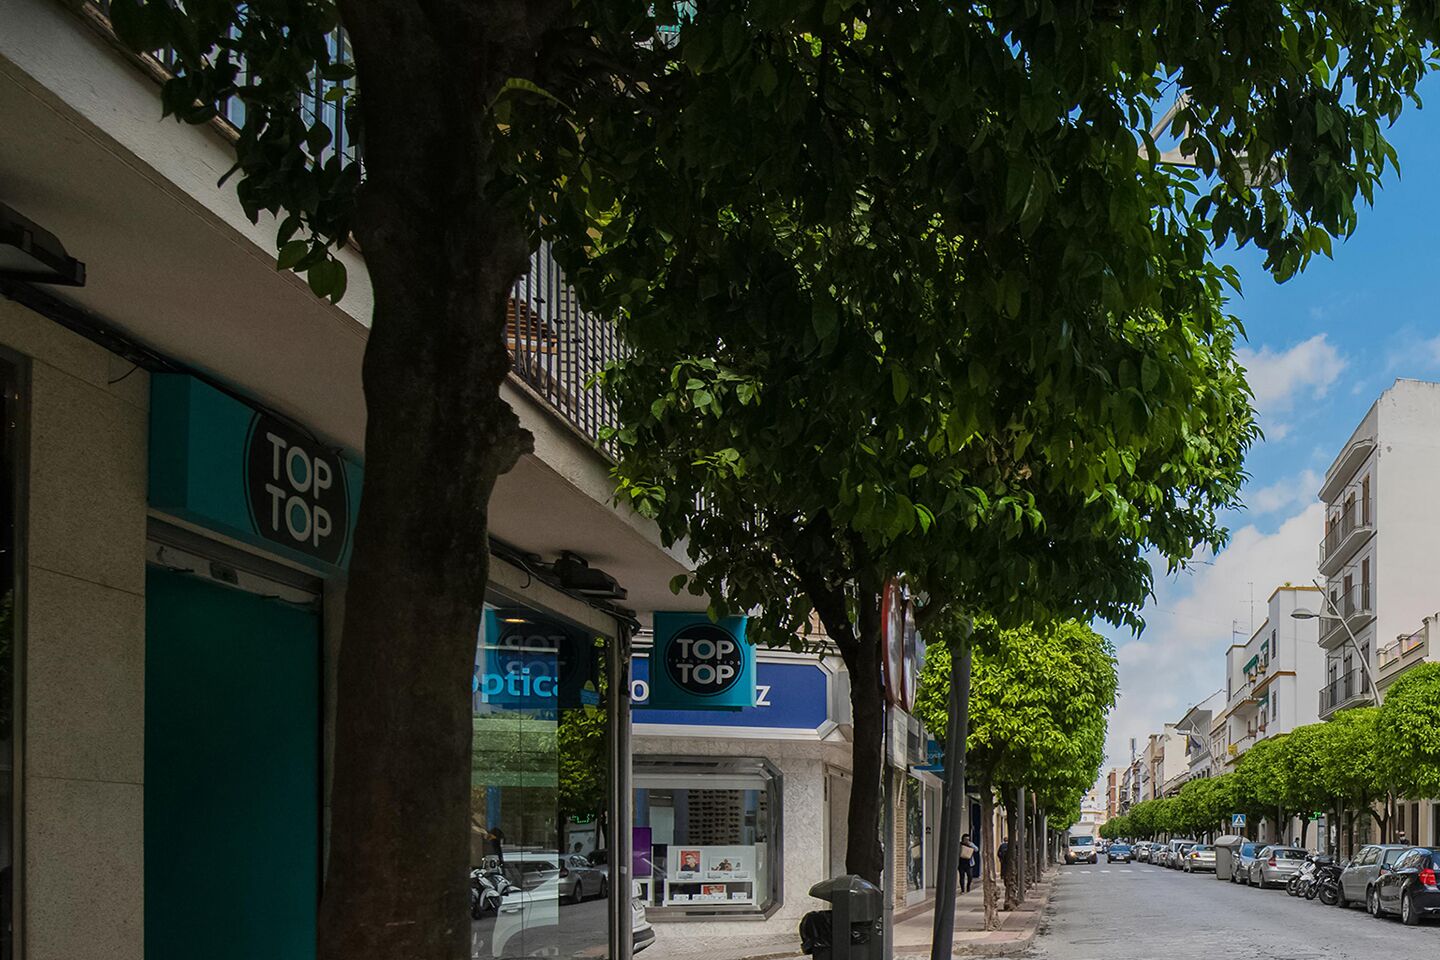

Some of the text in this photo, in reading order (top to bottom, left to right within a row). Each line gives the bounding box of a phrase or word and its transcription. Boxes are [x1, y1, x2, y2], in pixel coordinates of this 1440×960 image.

[266, 431, 333, 500] TOP
[265, 483, 332, 548] TOP
[676, 638, 735, 660] TOP
[676, 663, 735, 685] TOP
